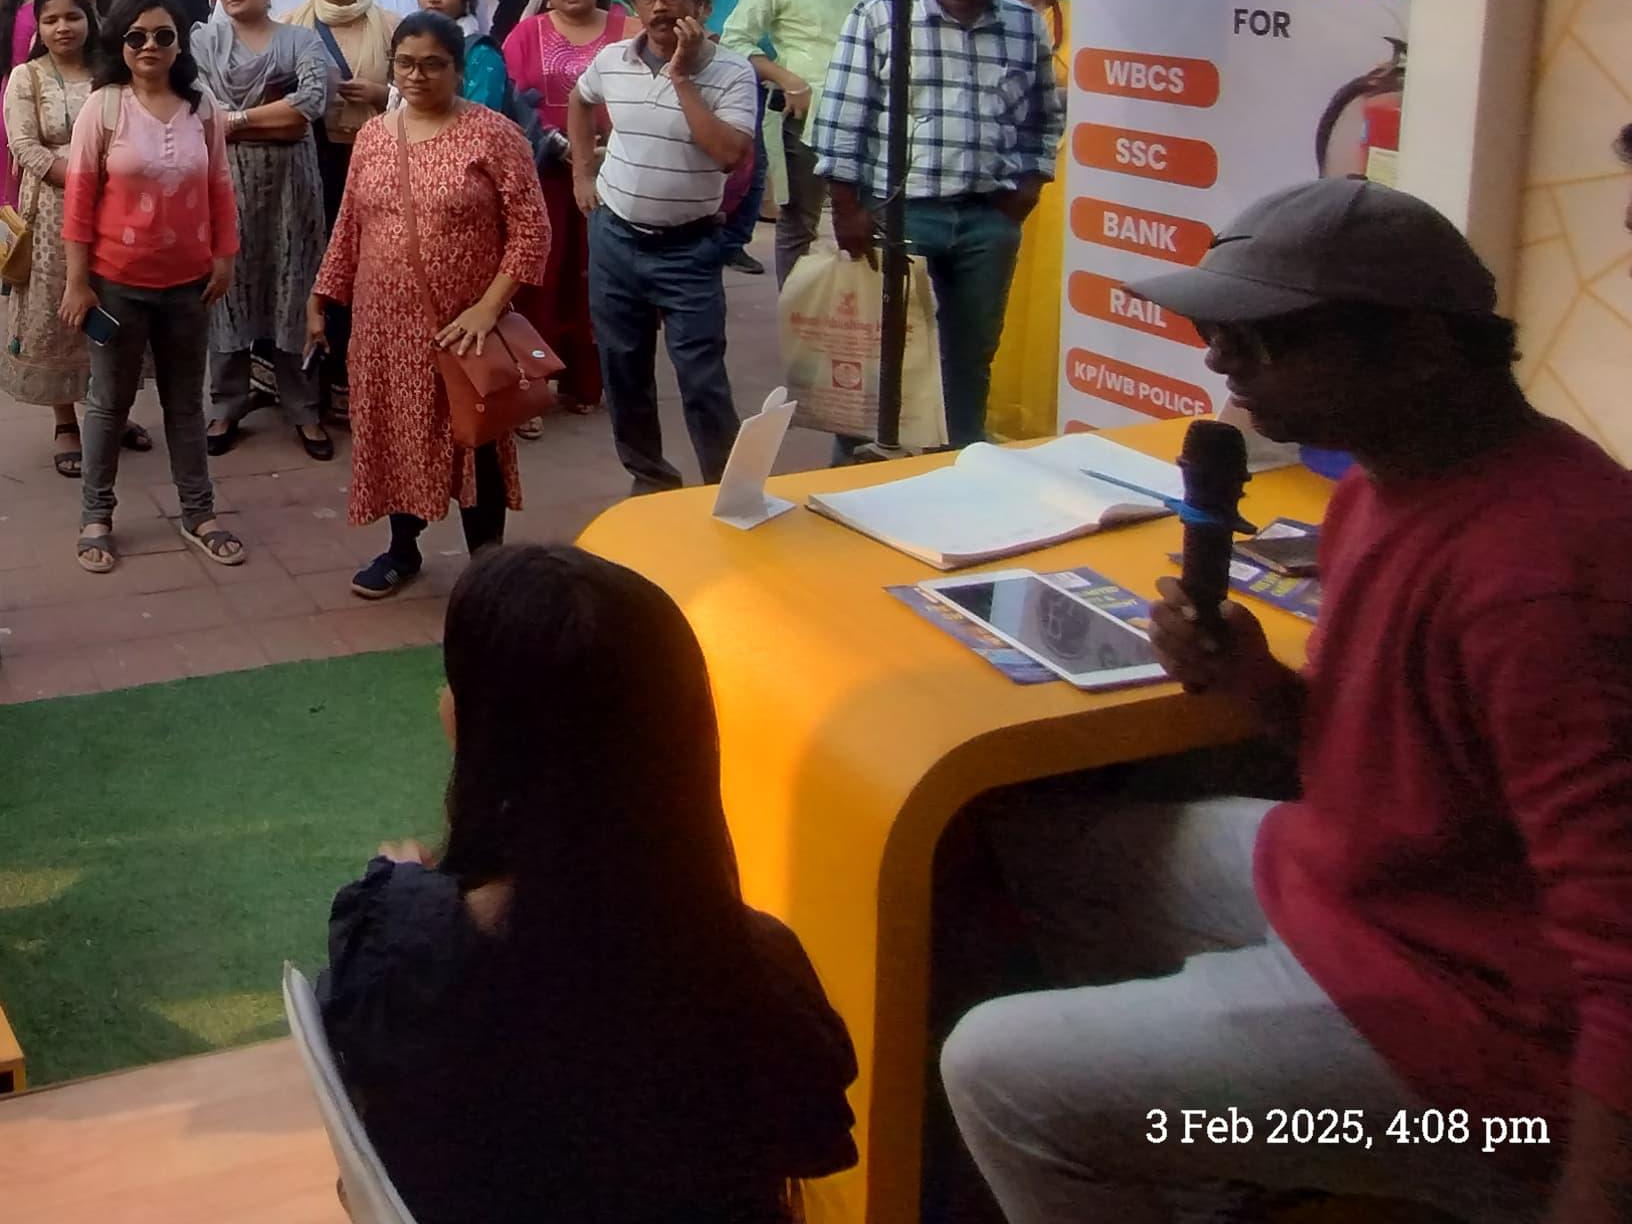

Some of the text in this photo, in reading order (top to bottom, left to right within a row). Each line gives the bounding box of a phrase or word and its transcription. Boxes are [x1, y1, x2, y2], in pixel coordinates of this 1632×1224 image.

[1233, 8, 1291, 38] FOR
[1104, 59, 1185, 94] WBCS
[1115, 137, 1167, 170] SSC
[1103, 210, 1179, 253] BANK
[1110, 288, 1168, 328] RAIL
[1074, 360, 1205, 416] KP/WB POLICE
